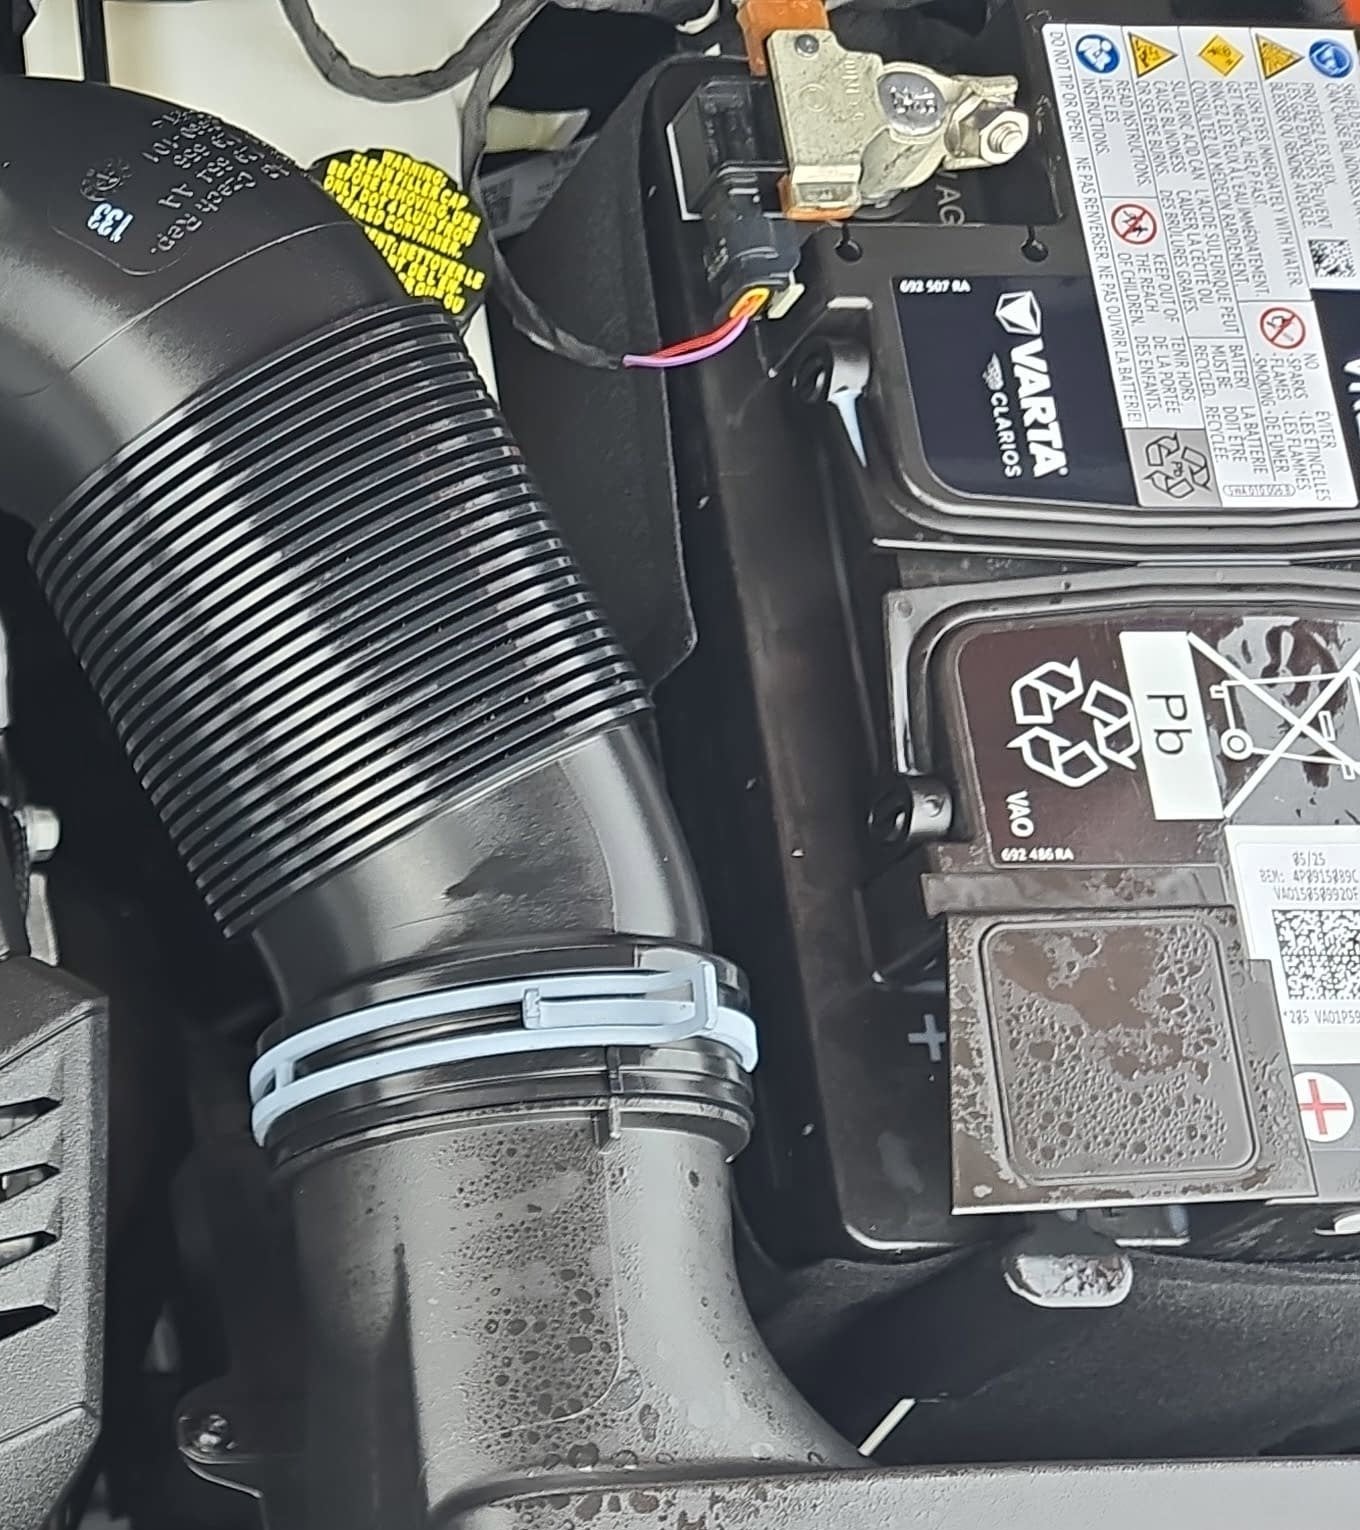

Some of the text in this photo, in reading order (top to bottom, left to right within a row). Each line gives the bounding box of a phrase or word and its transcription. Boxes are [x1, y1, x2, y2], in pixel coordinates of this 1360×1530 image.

[1049, 32, 1066, 47] DO
[1053, 50, 1071, 70] NOT
[1057, 74, 1075, 89] TIP
[1114, 79, 1135, 108] READ
[1134, 80, 1151, 96] OR
[1225, 81, 1243, 99] GET
[1061, 92, 1079, 108] OR
[1097, 78, 1120, 122] LIRE LES
[1190, 81, 1217, 140] CONSULTEZ
[1207, 81, 1229, 115] RINCEZ
[1242, 81, 1264, 114] FLUSH
[1138, 98, 1160, 137] SEVERE
[1151, 80, 1186, 174] CAUSE BLINDNESS
[1169, 80, 1206, 180] SULFURIC ACID CAN
[1215, 118, 1234, 137] LES
[1230, 102, 1254, 147] MEDICAL
[1250, 116, 1270, 141] EYES
[1203, 144, 1221, 158] UN
[1220, 138, 1241, 164] YEUX
[1312, 138, 1331, 156] LES
[1074, 157, 1092, 171] NE
[1240, 150, 1261, 176] HELP
[1078, 175, 1096, 194] PAS
[440, 188, 470, 210] CAP
[1158, 189, 1177, 209] DES
[1175, 190, 1198, 229] CAUSER
[86, 203, 134, 243] 133
[451, 205, 482, 233] USE
[1273, 216, 1294, 244] WITH
[1185, 232, 1202, 246] LA
[1096, 265, 1114, 280] NE
[1116, 252, 1133, 267] OF
[1100, 282, 1119, 302] PAS
[1133, 253, 1160, 312] THE REACH
[1151, 254, 1180, 323] KEEP OUT OF
[1202, 232, 1233, 302] SULFURIQUE
[1218, 305, 1240, 333] PEUT
[1197, 288, 1215, 304] OU
[1105, 305, 1128, 347] OUVRIR
[1133, 335, 1151, 356] DES
[1151, 335, 1168, 350] DE
[1114, 350, 1131, 364] LA
[1154, 354, 1171, 367] LA
[1169, 335, 1197, 401] TENIR HORS
[1208, 344, 1233, 388] MUST BE
[1226, 344, 1251, 390] BATTERY
[1302, 352, 1320, 368] NO
[1010, 336, 1068, 478] VARTA
[1221, 406, 1241, 431] DOIT
[990, 390, 1023, 479] CLARIOS
[1239, 405, 1269, 474] LA BATTERIE
[1267, 435, 1290, 472] FUMER
[1285, 436, 1311, 490] FLAMMES
[1170, 461, 1184, 477] Pb
[1146, 694, 1193, 755] Pb
